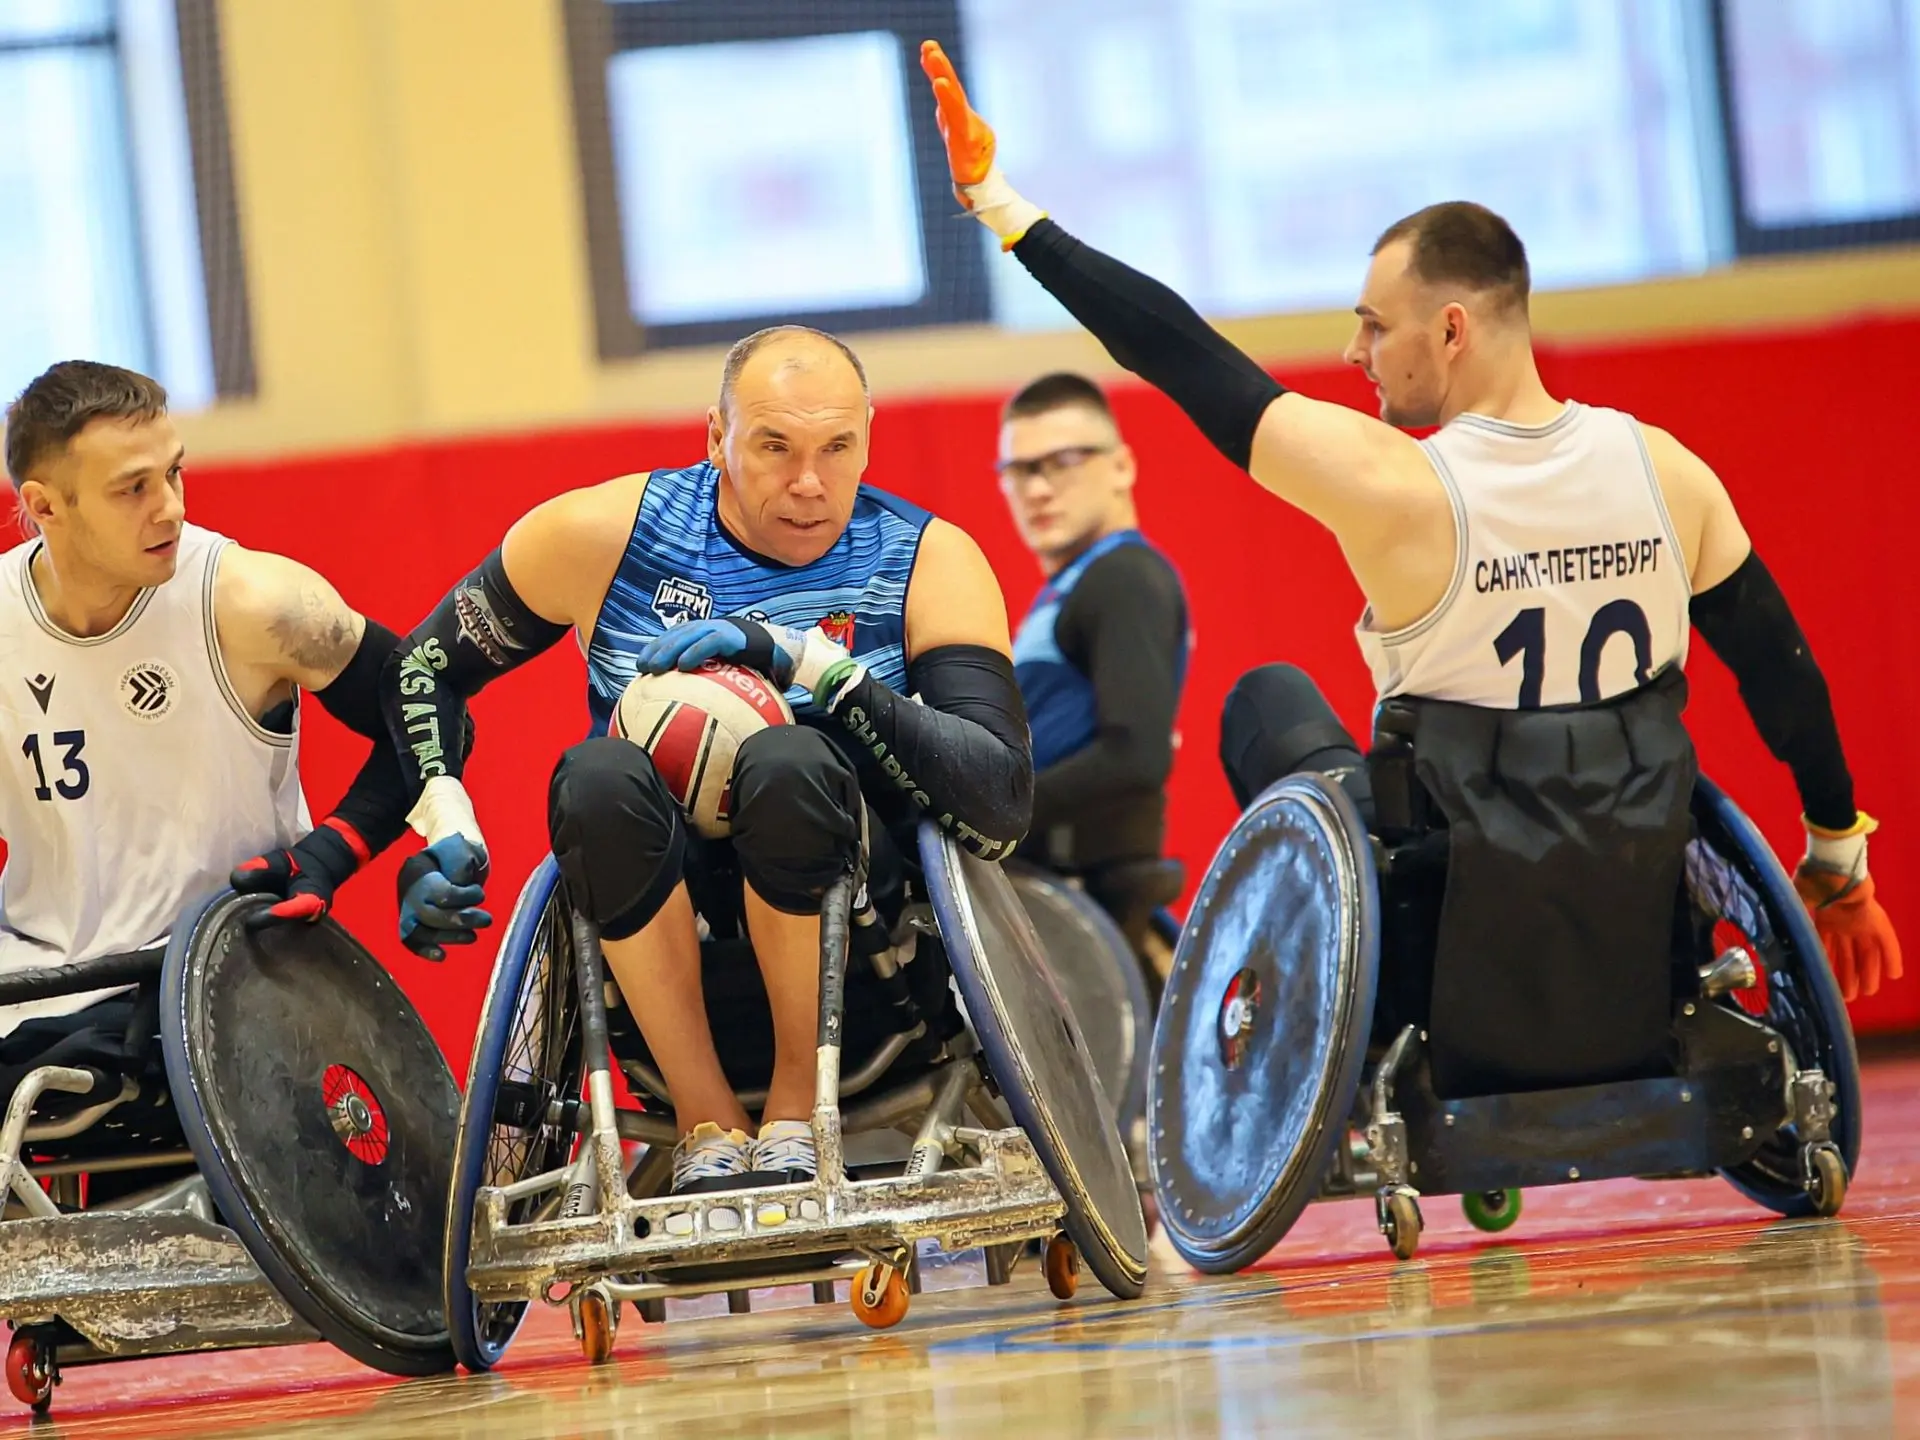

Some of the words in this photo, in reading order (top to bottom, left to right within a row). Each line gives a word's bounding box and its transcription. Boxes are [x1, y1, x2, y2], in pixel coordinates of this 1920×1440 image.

[1475, 537, 1662, 593] САНКТ-ПЕТЕРБУРГ
[702, 659, 768, 708] olten
[22, 730, 90, 801] 13
[401, 703, 447, 780] ATTAC
